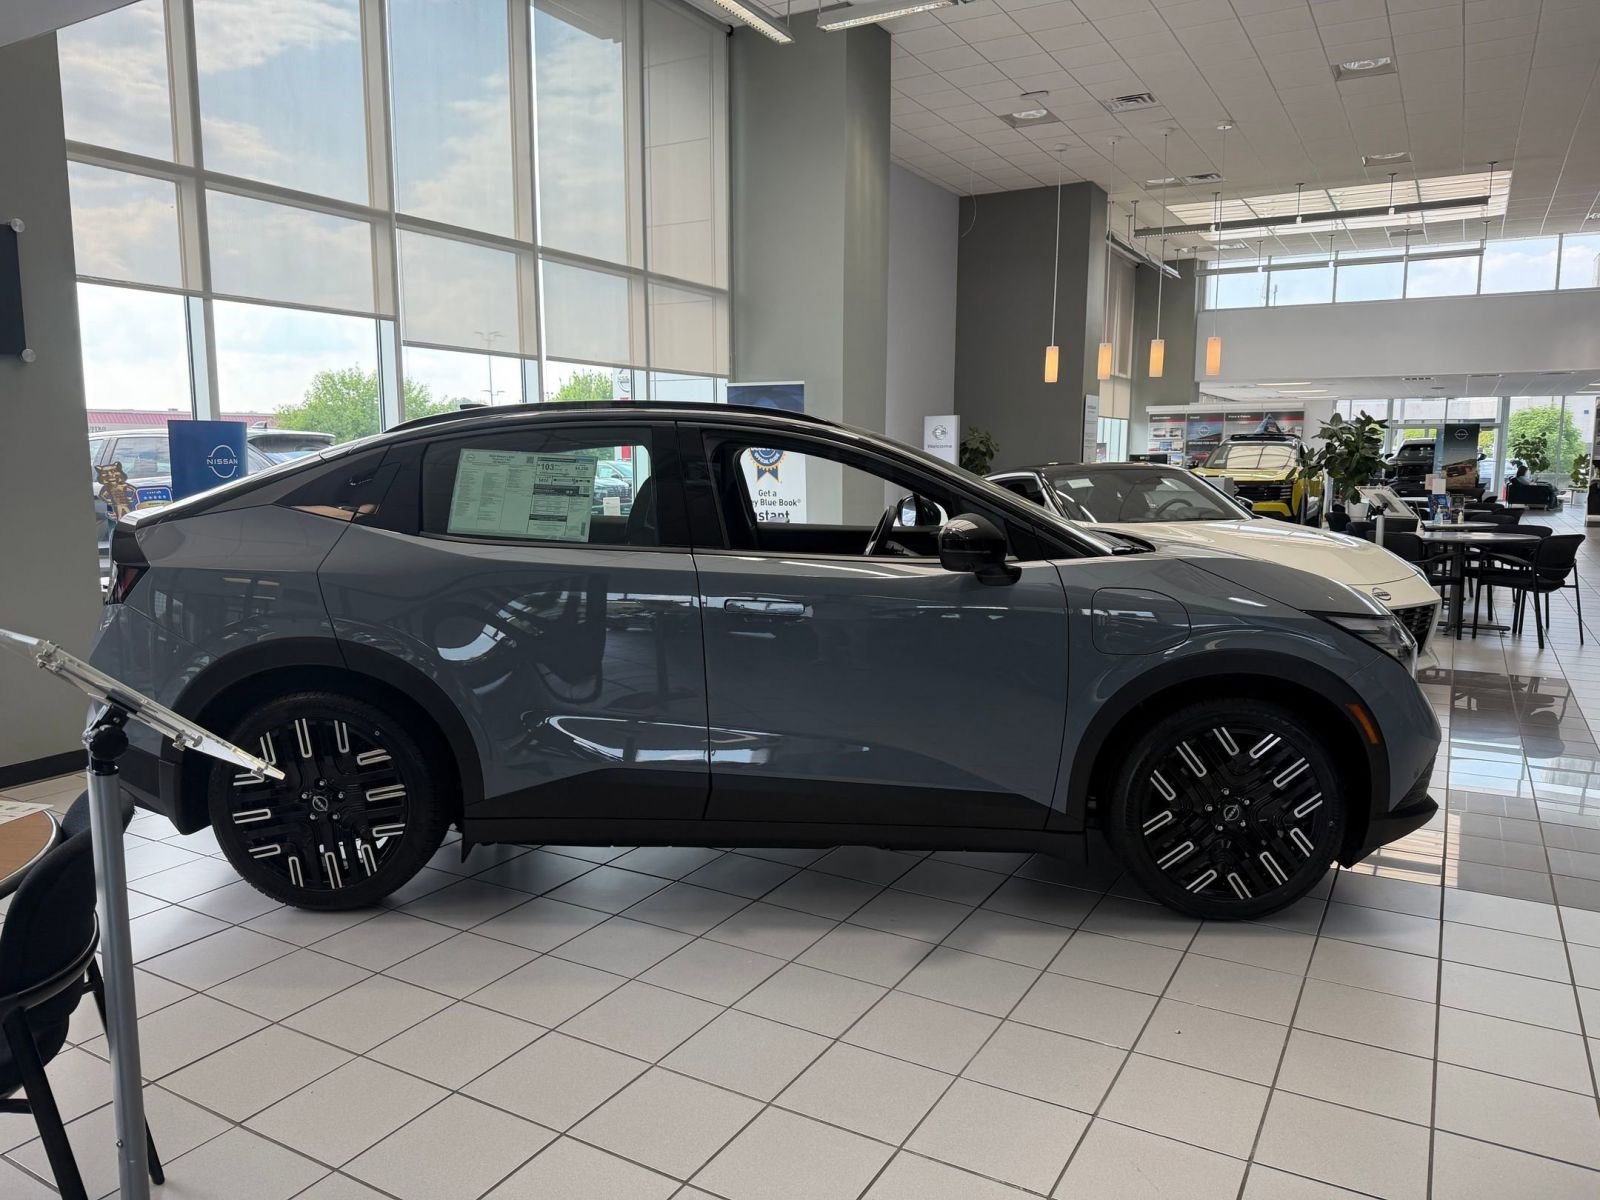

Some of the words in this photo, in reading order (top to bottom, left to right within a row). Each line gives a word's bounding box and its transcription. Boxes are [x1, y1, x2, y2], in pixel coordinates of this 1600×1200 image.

[541, 463, 555, 471] 103
[758, 489, 771, 497] Get
[760, 498, 777, 506] Blue
